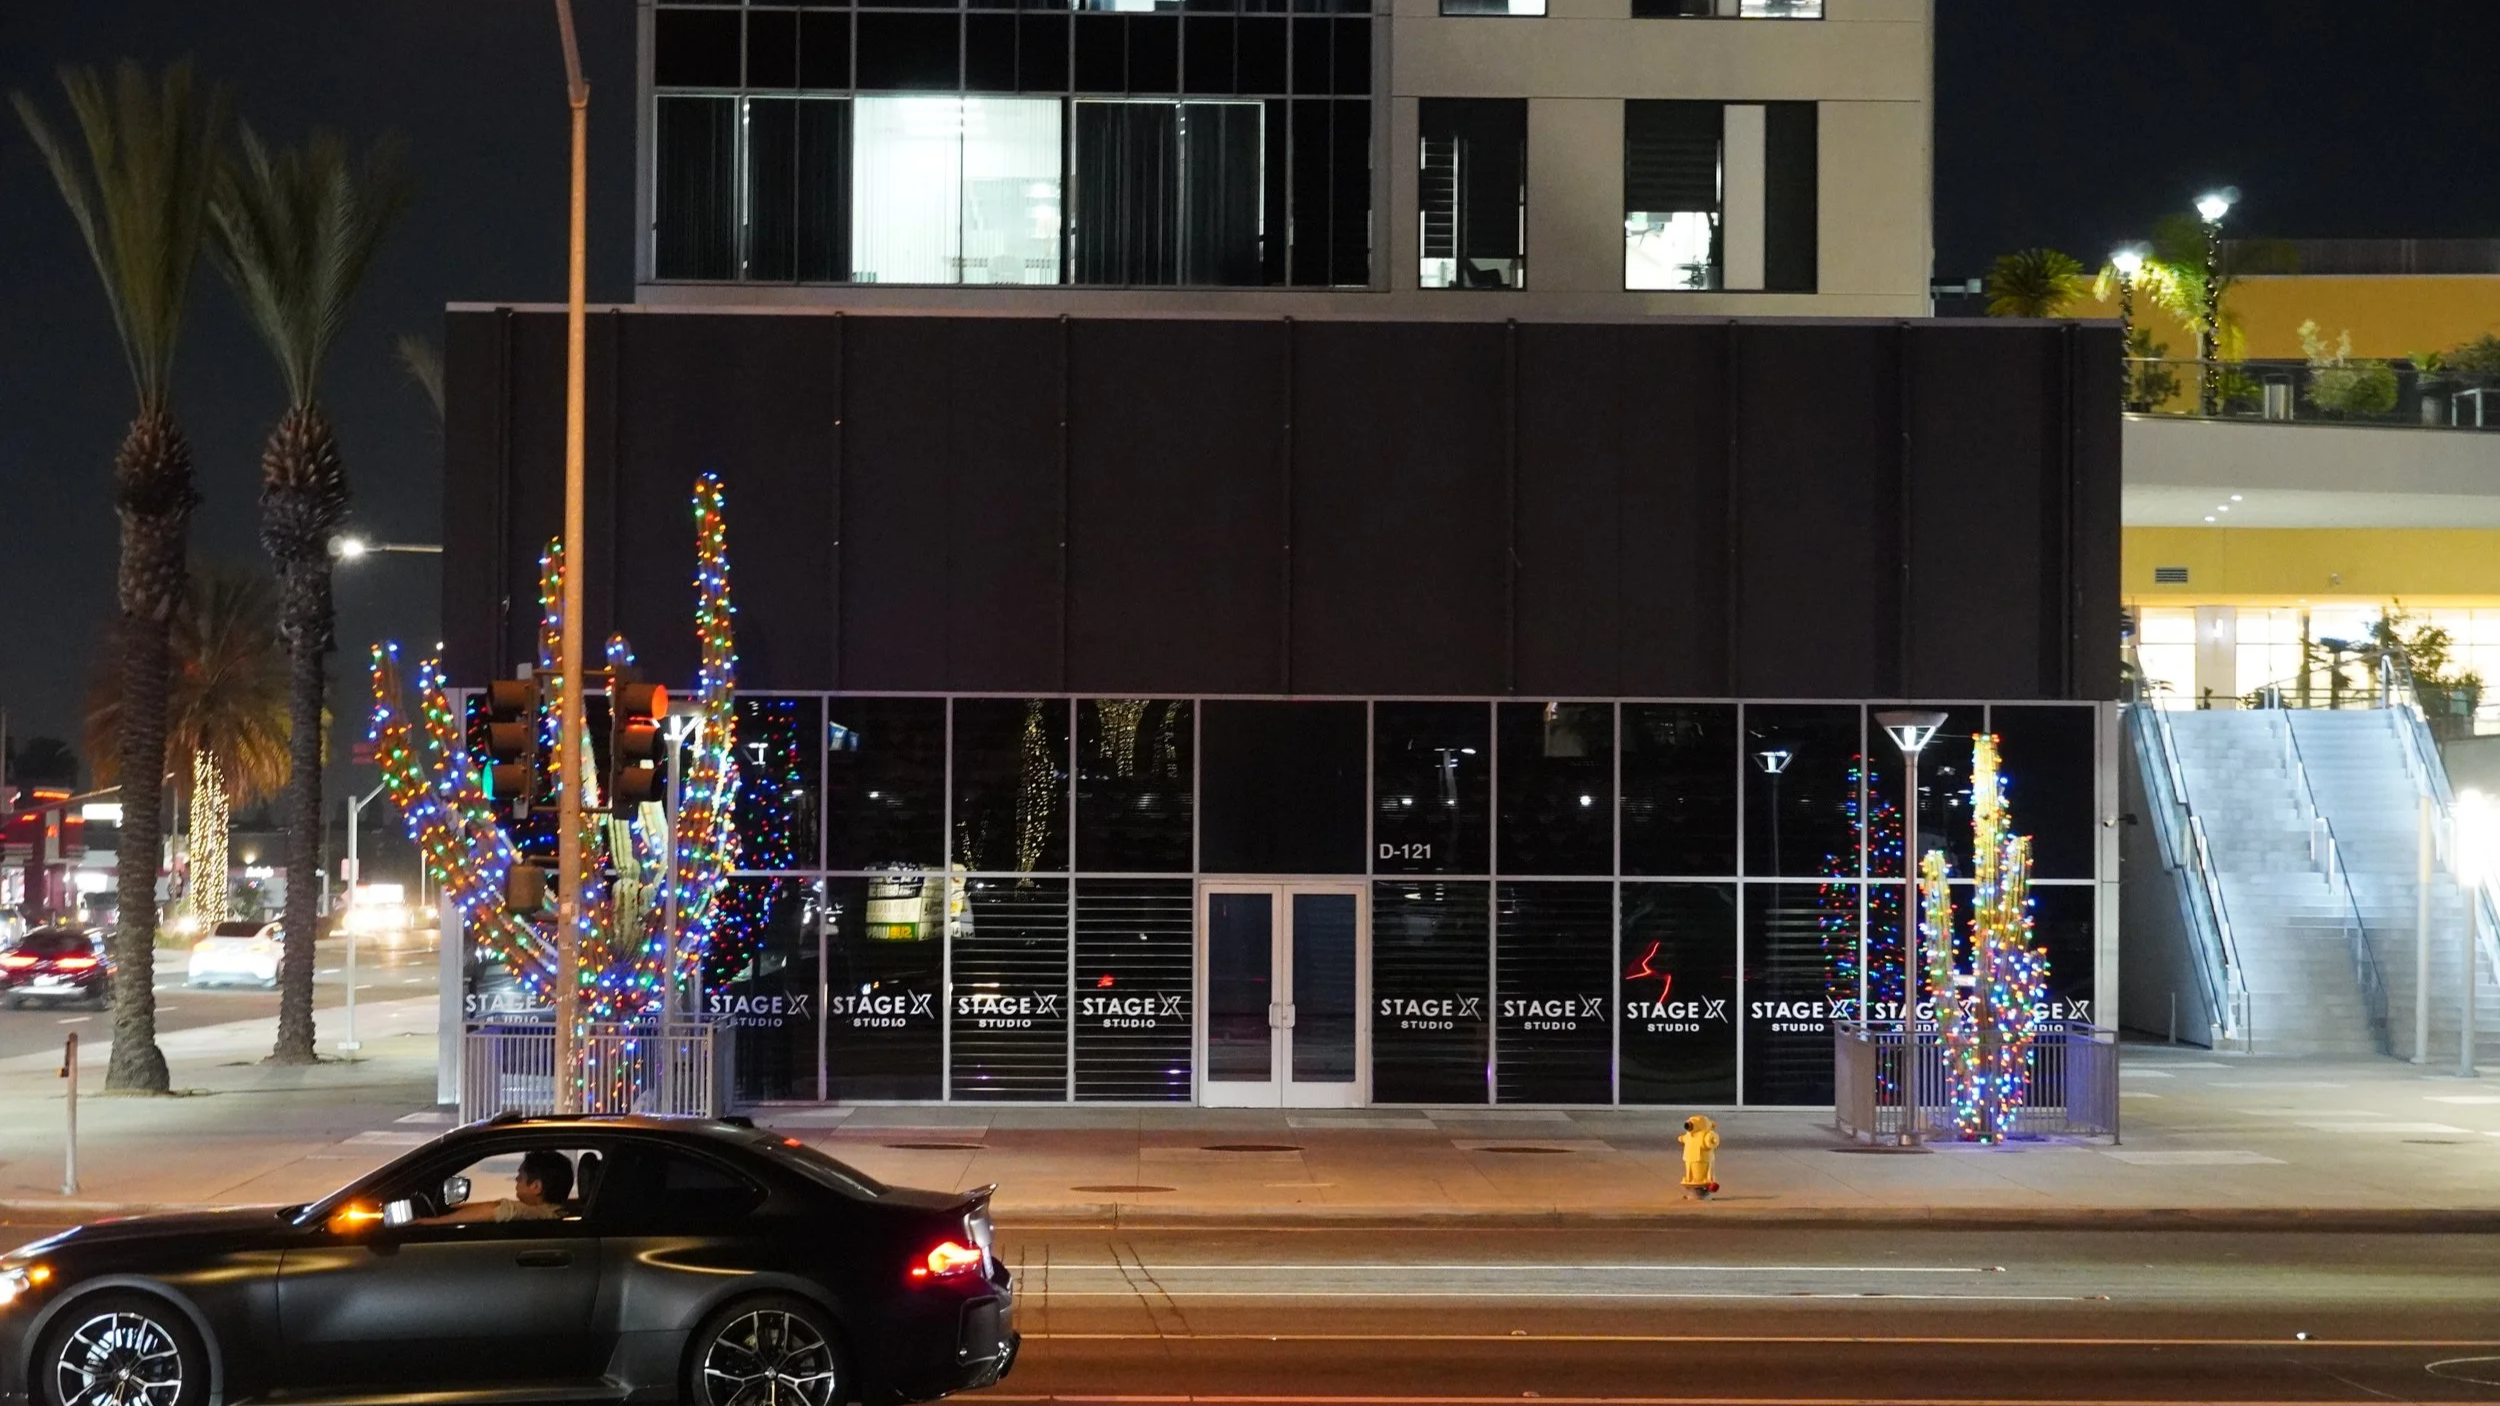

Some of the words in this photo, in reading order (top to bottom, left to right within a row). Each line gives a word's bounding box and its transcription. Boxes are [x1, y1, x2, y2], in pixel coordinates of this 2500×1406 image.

[1379, 843, 1431, 859] D-121
[465, 994, 537, 1013] STAGE
[710, 994, 783, 1015] STAGE
[833, 995, 906, 1015] STAGE
[957, 996, 1031, 1015] STAGE
[1082, 997, 1156, 1016] STAGE
[1380, 998, 1453, 1017] STAGE
[1503, 1000, 1576, 1018] STAGE
[1626, 1001, 1699, 1019] STAGE
[1751, 1001, 1824, 1019] STAGE
[853, 1017, 907, 1028] STUDIO
[978, 1018, 1032, 1028] STUDIO
[1102, 1018, 1156, 1028] STUDIO
[1401, 1020, 1454, 1030] STUDIO
[1524, 1021, 1577, 1031] STUDIO
[1647, 1023, 1700, 1032] STUDIO
[1771, 1022, 1825, 1032] STUDIO
